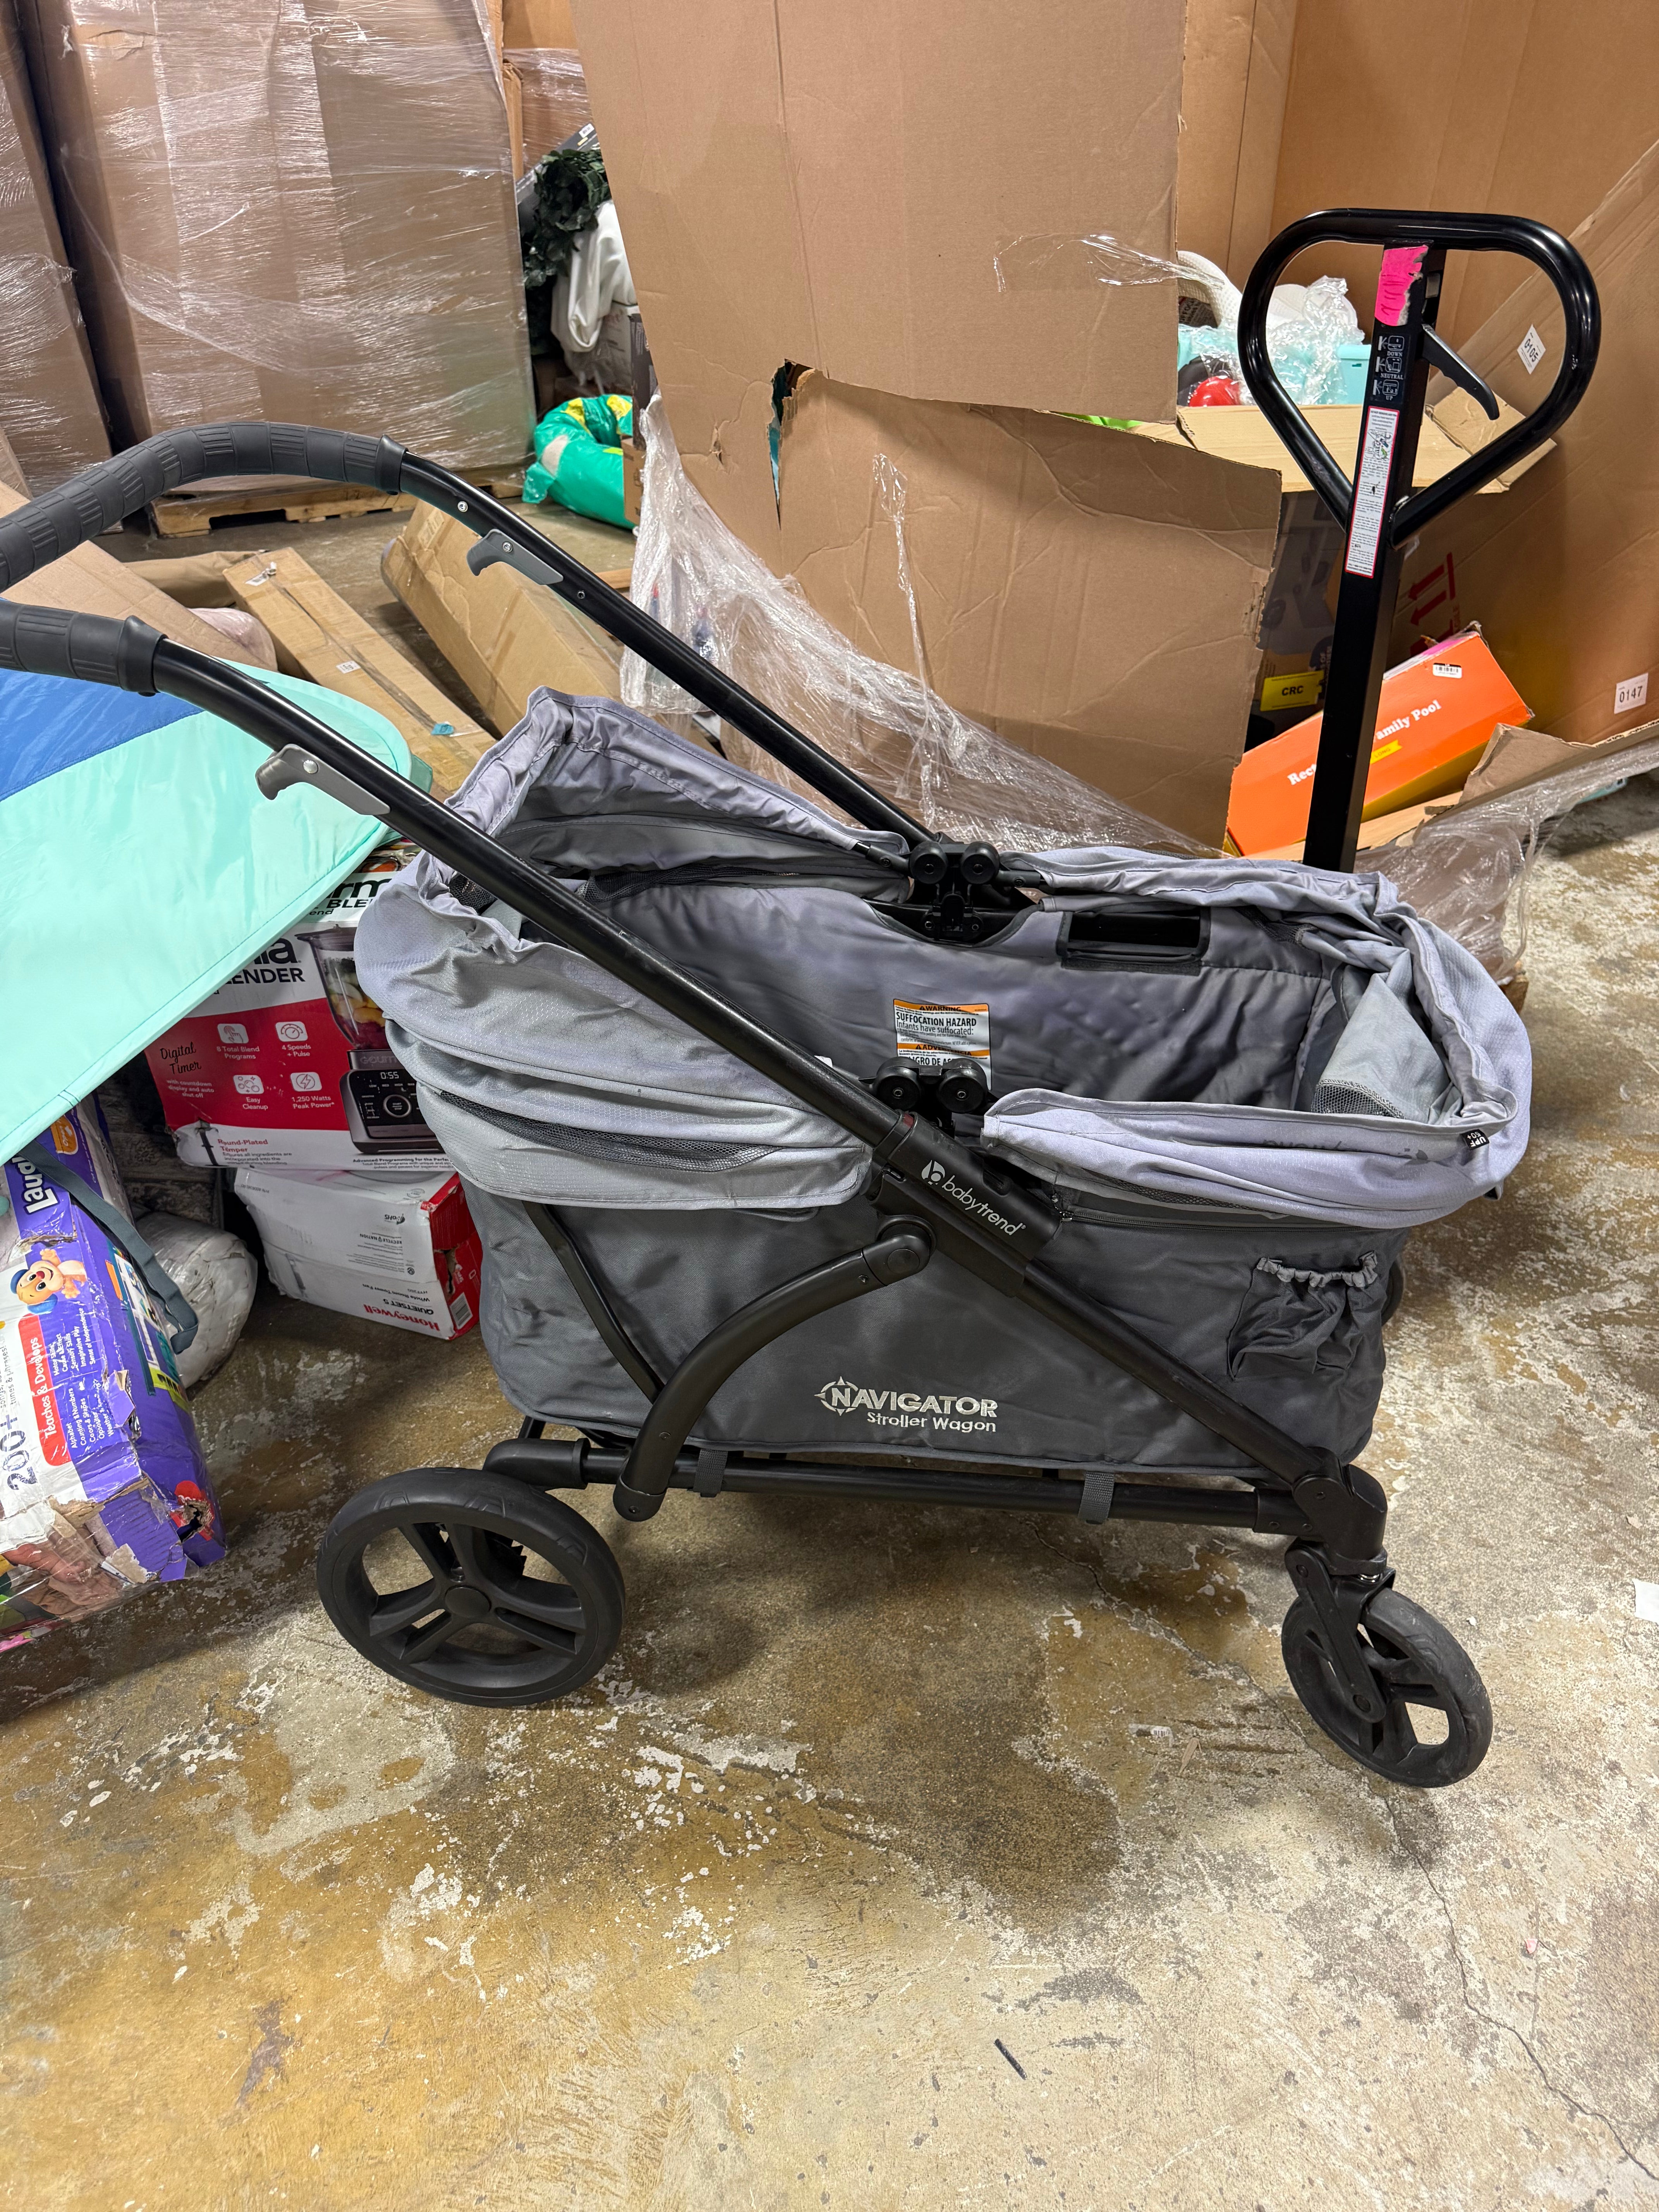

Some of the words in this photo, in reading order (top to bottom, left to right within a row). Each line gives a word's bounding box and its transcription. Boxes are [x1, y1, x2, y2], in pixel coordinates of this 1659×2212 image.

[1281, 685, 1304, 696] CRC
[1620, 685, 1643, 703] 0147
[1411, 700, 1441, 721] Pool
[1374, 716, 1410, 742] amily
[1374, 748, 1391, 758] LONG
[327, 898, 374, 908] BLE
[225, 968, 306, 985] ENDER
[896, 1012, 944, 1026] SUFFOCATION
[946, 1018, 977, 1026] HAZARD
[896, 1020, 919, 1031] Infants
[921, 1024, 936, 1033] have
[938, 1026, 974, 1035] suffocated:
[160, 1041, 196, 1063] Digital
[169, 1061, 201, 1074] Timer
[1467, 1132, 1481, 1140] 50+
[1470, 1137, 1486, 1147] UPF
[942, 1175, 1023, 1235] babytrend
[364, 1304, 440, 1331] Honeywell
[391, 1301, 434, 1314] QUIETSET
[79, 1308, 91, 1343] Independence
[31, 1337, 46, 1385] Develops
[76, 1338, 86, 1367] Imaginative
[9, 1384, 17, 1405] tunes
[38, 1384, 48, 1395] &
[69, 1388, 79, 1415] Numbers
[831, 1387, 998, 1418] NAVIGATOR
[42, 1395, 57, 1439] Teaches
[867, 1412, 927, 1429] Stroller
[933, 1417, 996, 1433] Wagon
[66, 1423, 78, 1448] Alphabet
[0, 1414, 38, 1491] 200+
